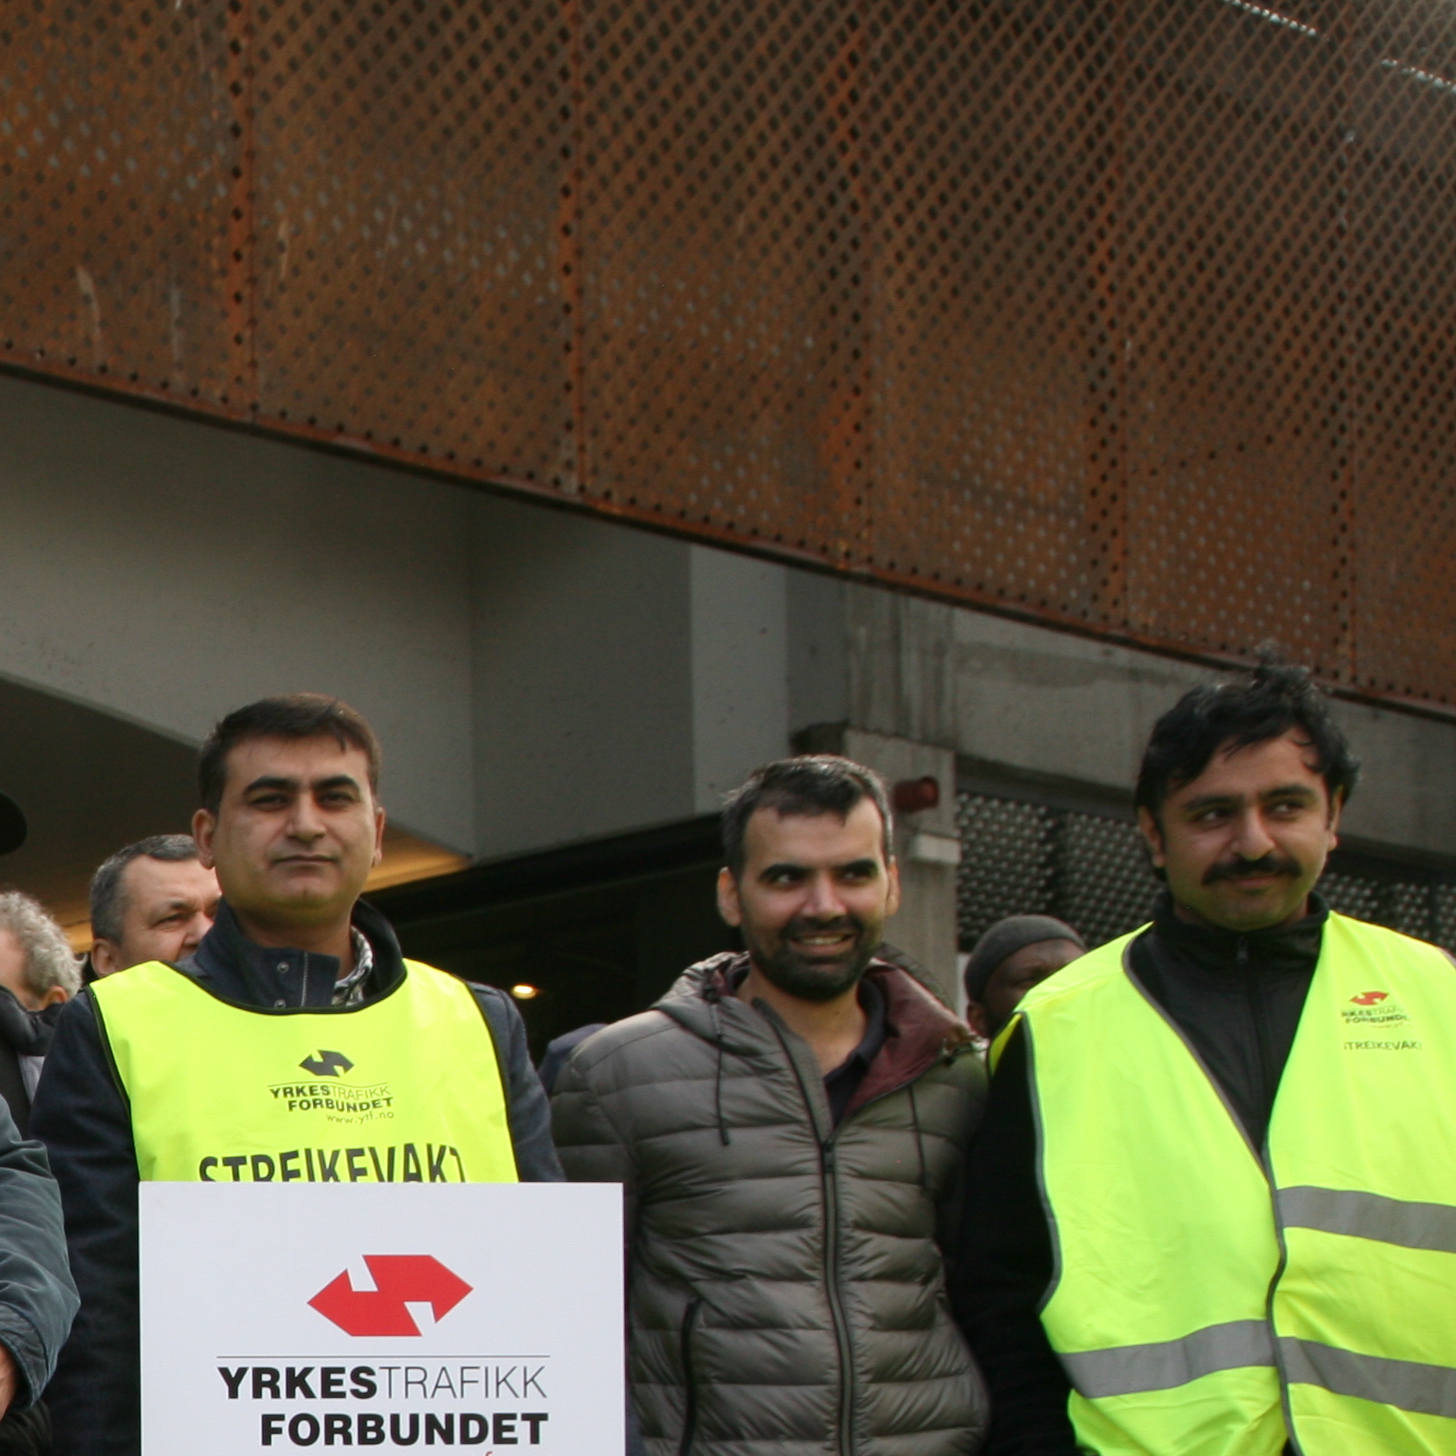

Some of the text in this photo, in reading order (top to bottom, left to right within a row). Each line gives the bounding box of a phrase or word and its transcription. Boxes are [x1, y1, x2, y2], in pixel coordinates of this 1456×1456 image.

[269, 1084, 391, 1100] YRKESTRAFIKK
[288, 1097, 394, 1112] FORBUNDET
[326, 1111, 395, 1125] www.ytf.no
[217, 1366, 548, 1400] YRKESTRAFIKK
[261, 1413, 549, 1447] FORBUNDET
